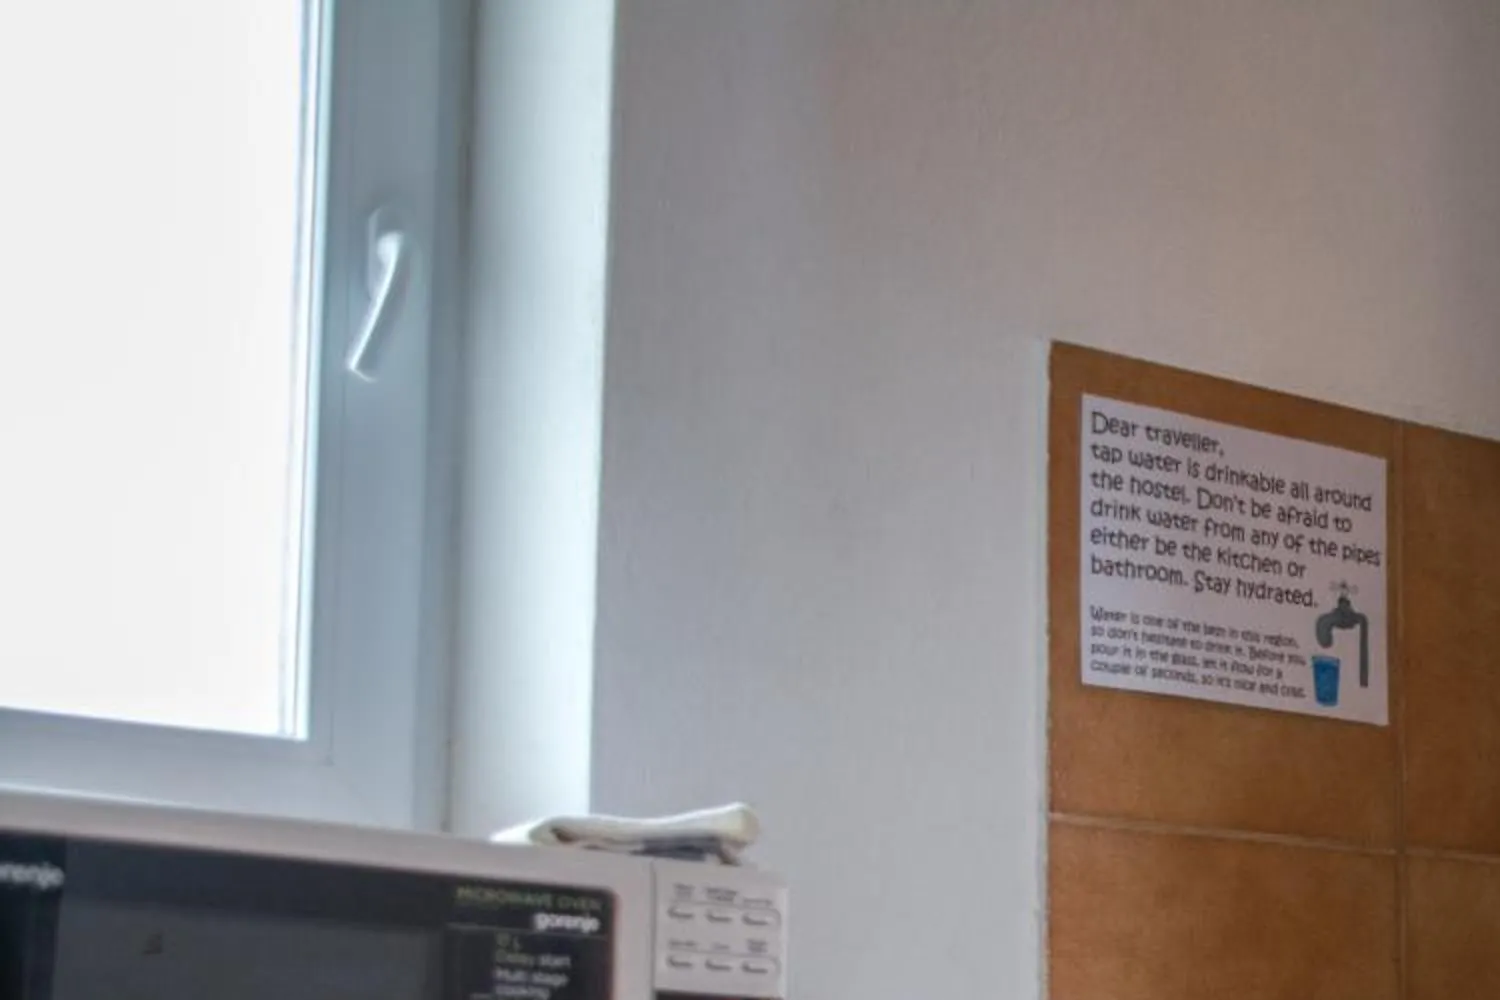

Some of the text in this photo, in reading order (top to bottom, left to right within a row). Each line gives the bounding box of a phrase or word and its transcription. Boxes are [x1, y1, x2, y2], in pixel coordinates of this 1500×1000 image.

[1091, 410, 1224, 458] Dear traveller,
[1090, 470, 1352, 532] the hostel. Don't be afraid to
[1091, 444, 1372, 512] tap water is drinkable all around
[1090, 499, 1381, 567] drink water from any of the pipes
[1090, 526, 1306, 578] either be the kitchen or
[1091, 553, 1319, 608] bathroom. Stay hydrated.
[1090, 605, 1127, 622] Water
[1182, 620, 1200, 633] the
[534, 911, 600, 934] gorenje
